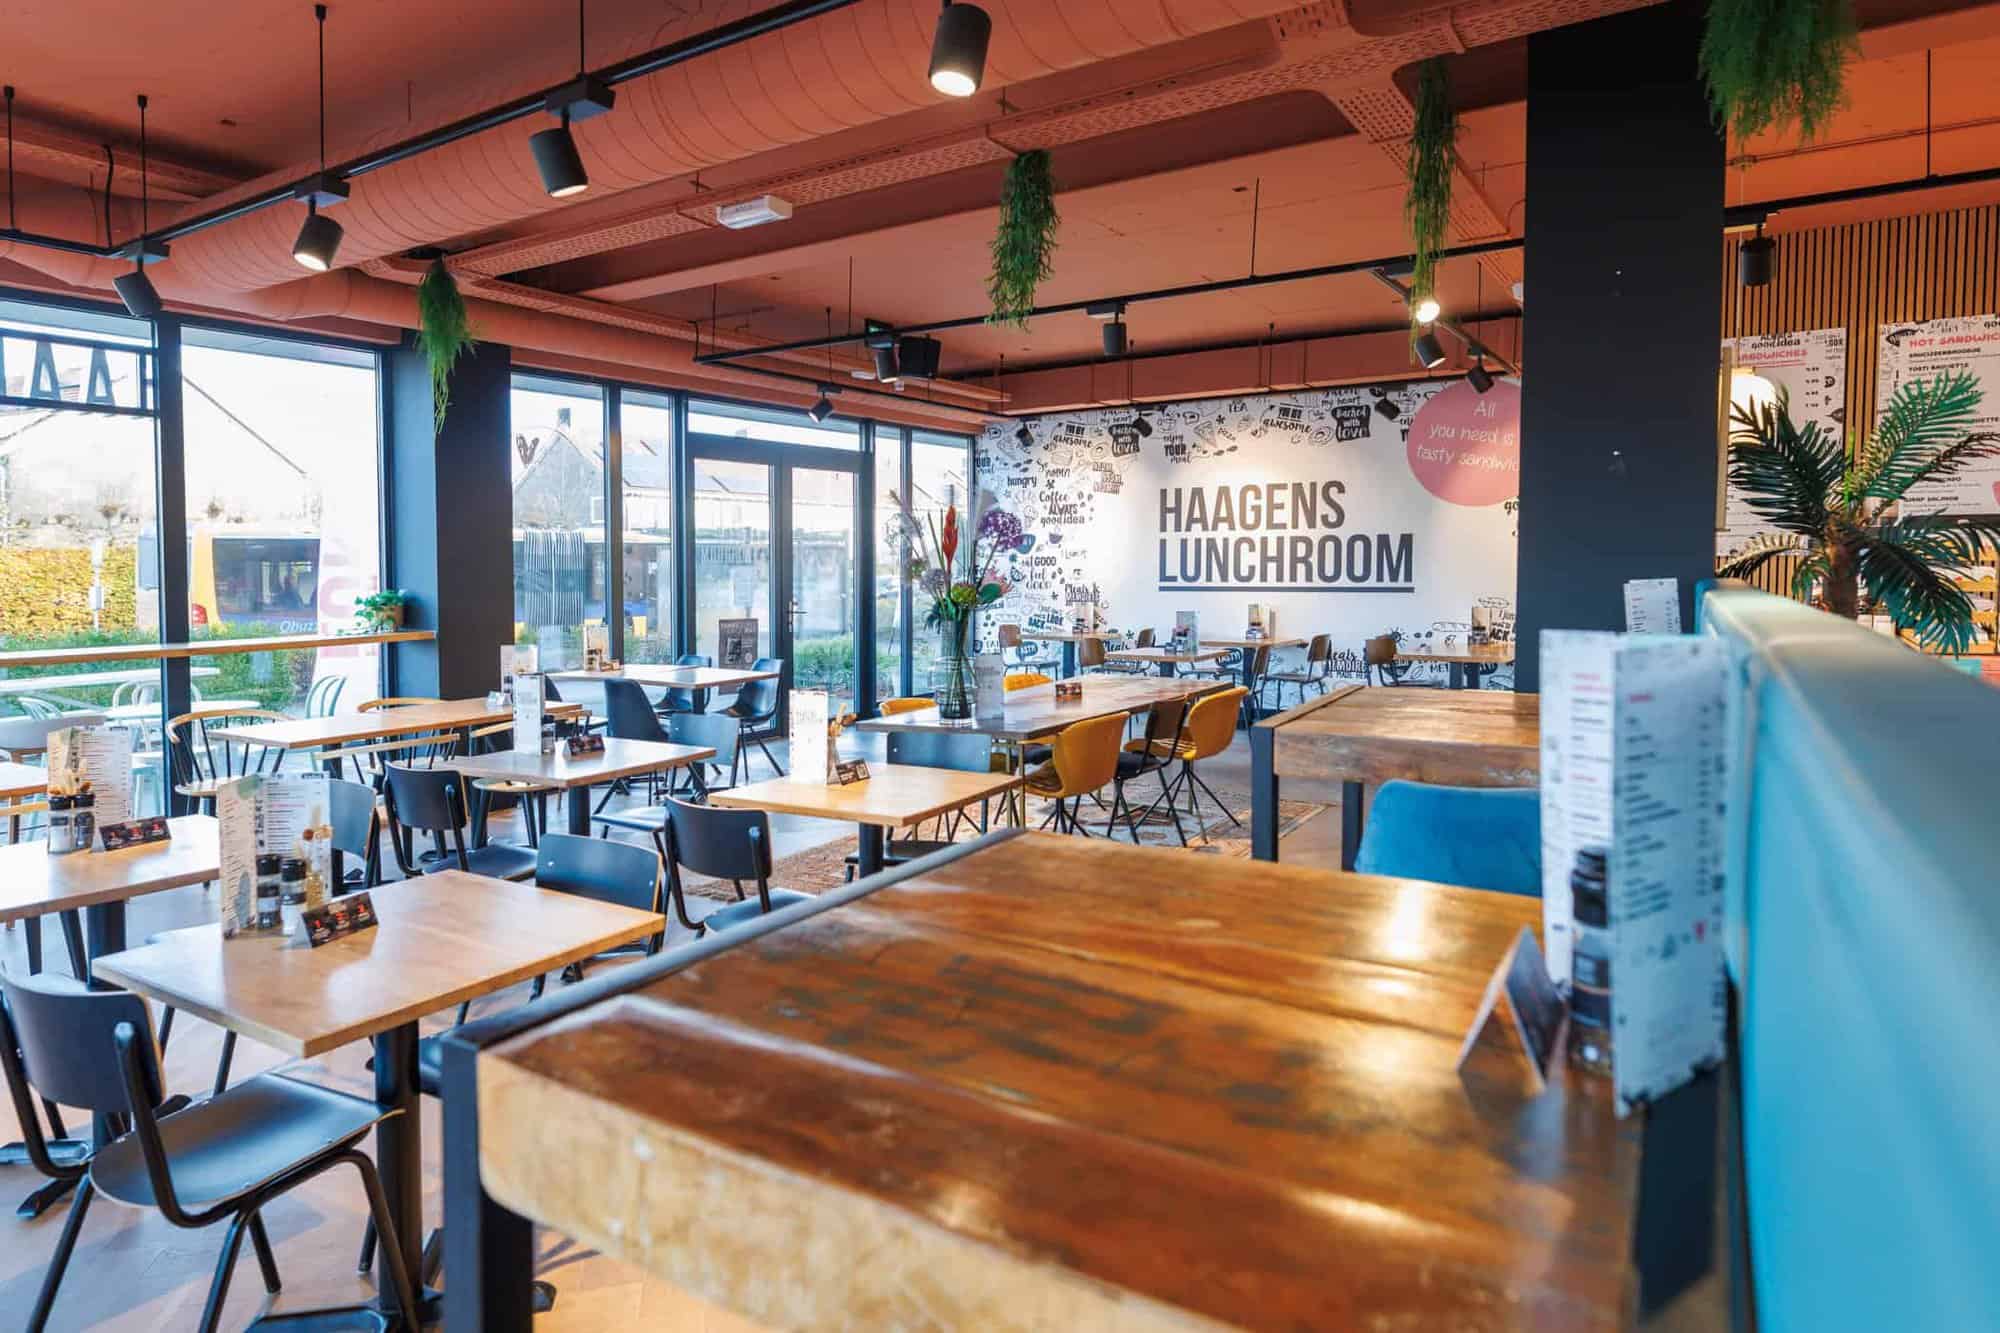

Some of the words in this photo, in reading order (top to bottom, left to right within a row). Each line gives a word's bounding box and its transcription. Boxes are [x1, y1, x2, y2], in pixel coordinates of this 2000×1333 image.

[1909, 339, 1934, 348] HOT
[1940, 333, 2000, 345] SANDWIC
[1737, 350, 1808, 360] ANDWICHES
[1473, 400, 1497, 417] All
[1429, 423, 1456, 440] you
[1459, 425, 1498, 444] need
[1415, 443, 1456, 466] tasty
[1457, 451, 1519, 473] sandwic
[1008, 475, 1038, 489] hungry
[1040, 490, 1068, 505] Coffee
[1159, 480, 1346, 532] HAAGENS
[1034, 556, 1057, 567] GOOD
[1159, 533, 1414, 583] LUNCHROOM
